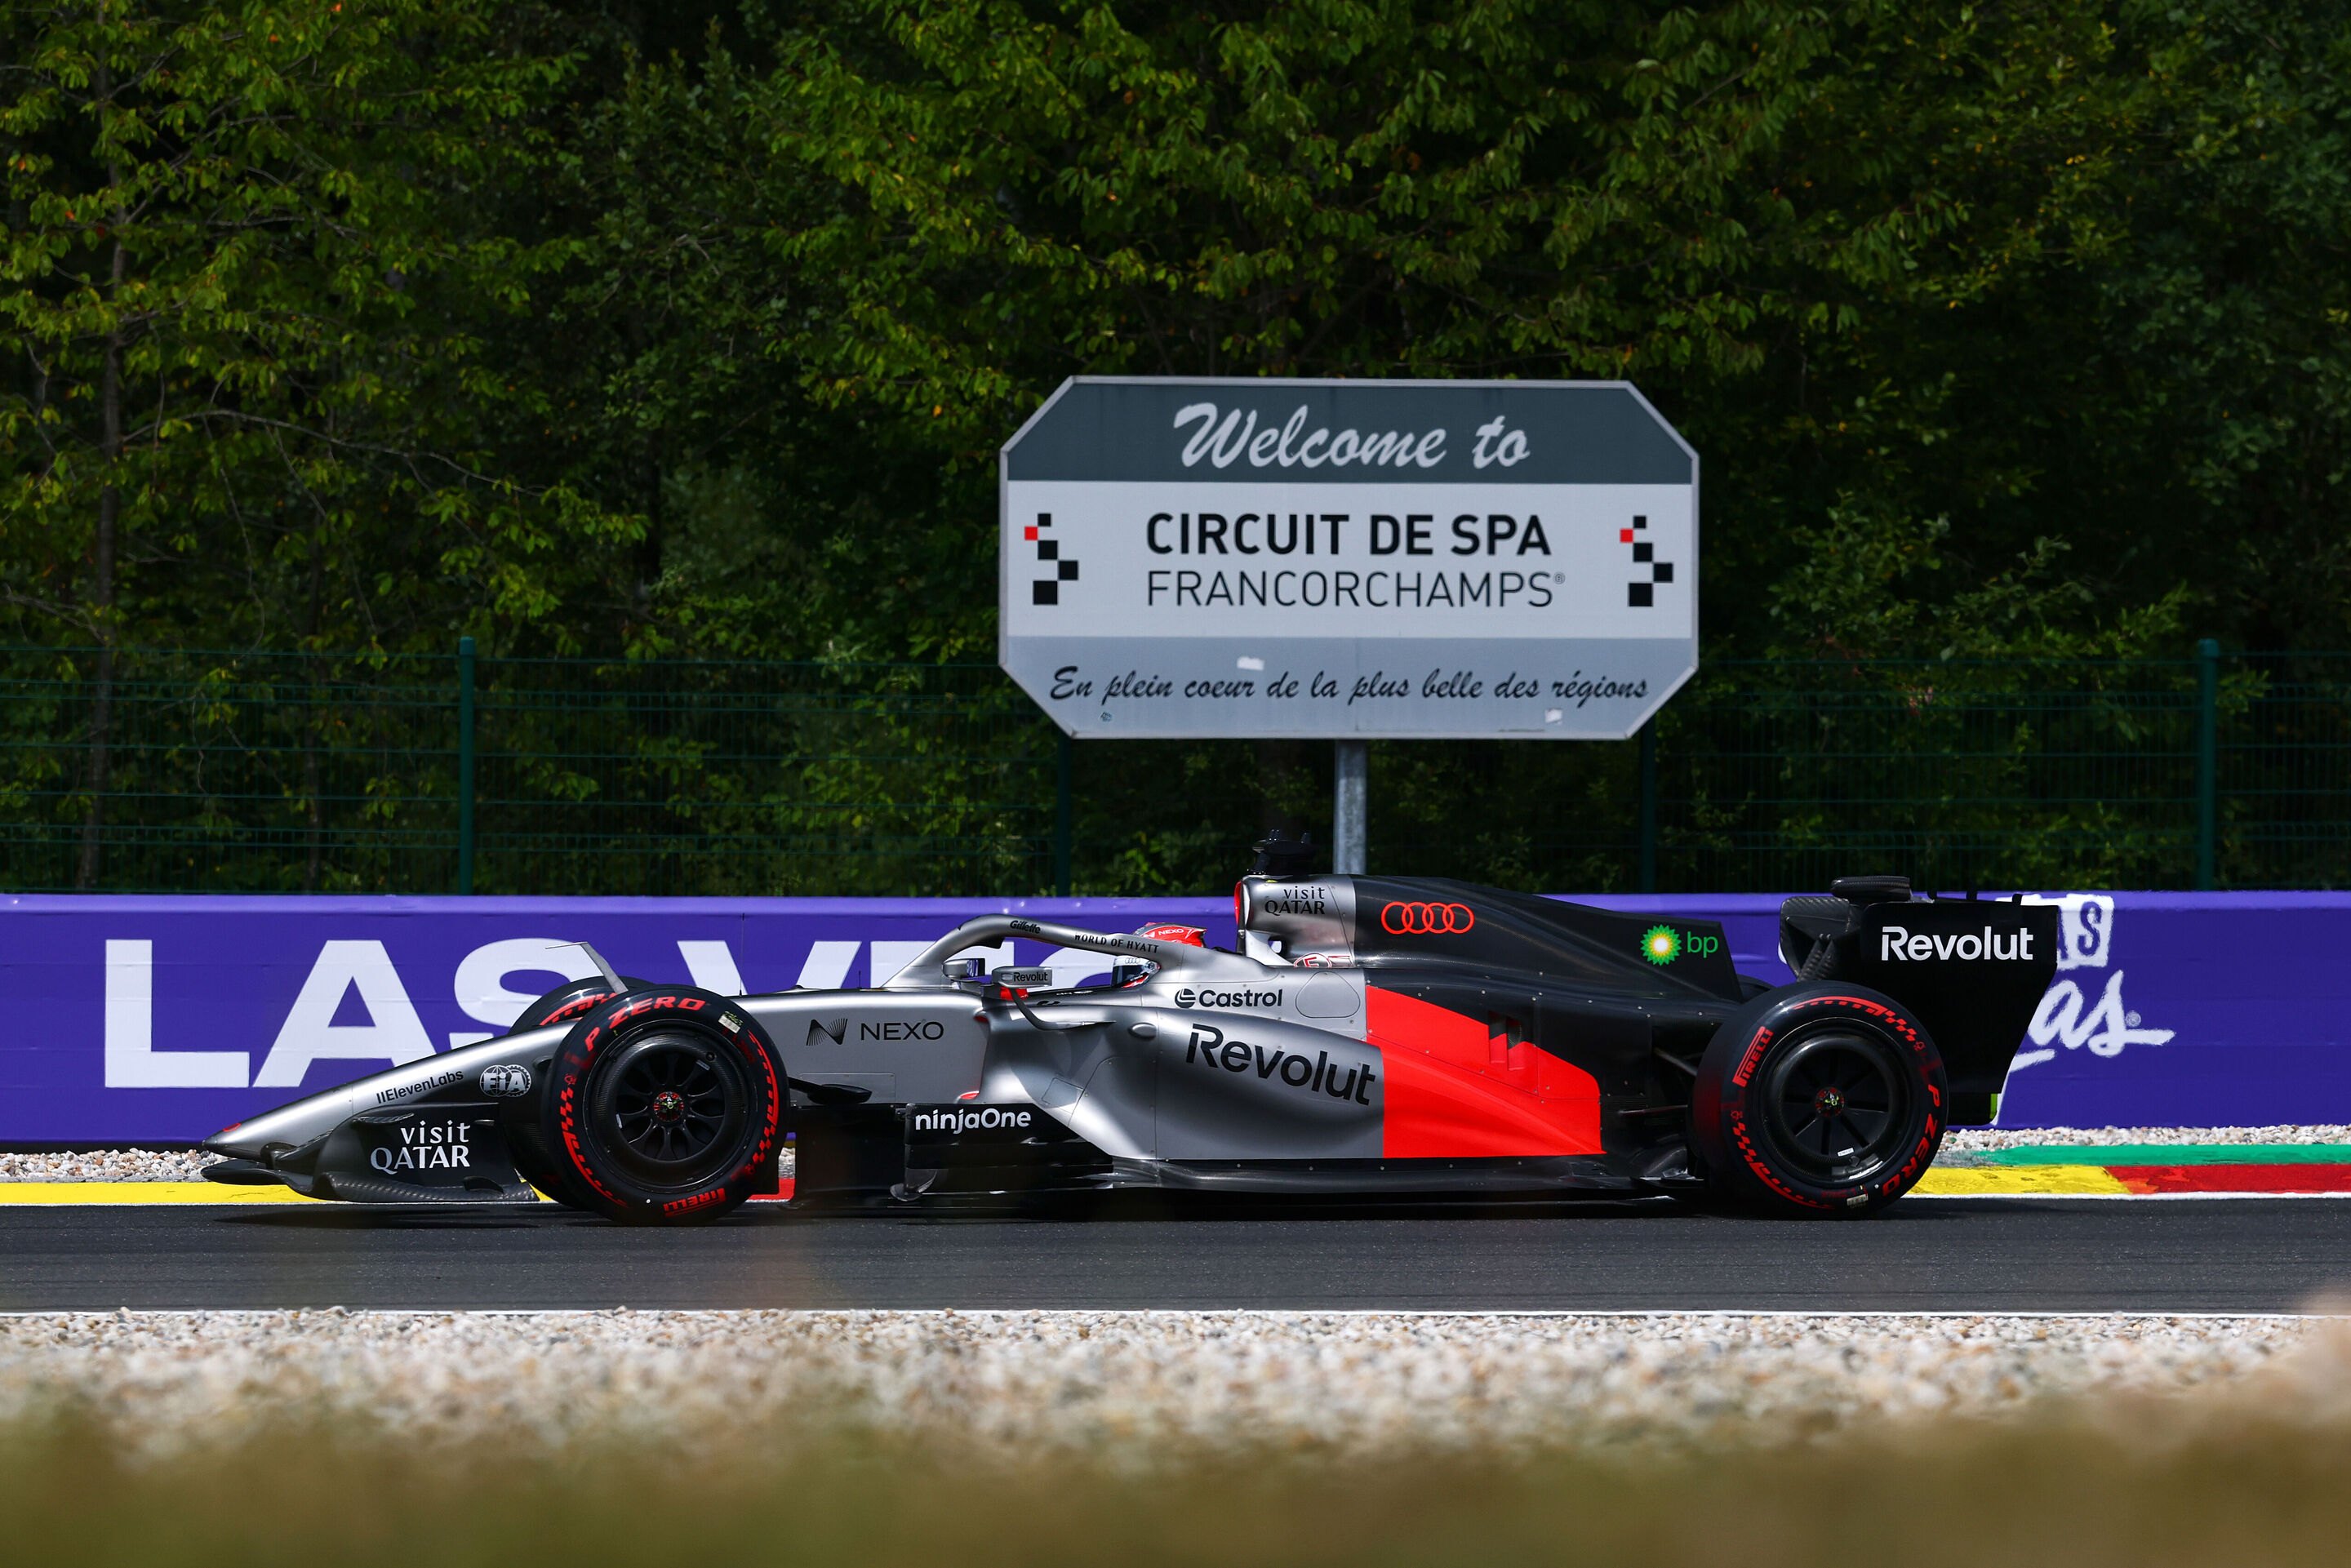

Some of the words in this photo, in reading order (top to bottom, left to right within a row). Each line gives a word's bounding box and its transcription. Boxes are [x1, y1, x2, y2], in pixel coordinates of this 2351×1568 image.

[1173, 402, 1447, 469] Welcome
[1471, 415, 1531, 470] to
[1146, 513, 1349, 556] CIRCUIT
[1370, 514, 1433, 556] DE
[1451, 514, 1552, 556] SPA
[1050, 665, 1091, 700] En
[1104, 670, 1173, 708] plein
[1184, 679, 1255, 700] coeur
[1266, 669, 1300, 701] de
[1310, 669, 1340, 700] la
[1348, 670, 1411, 708] plus
[1422, 671, 1484, 700] belle
[1494, 671, 1540, 700] des
[1552, 671, 1649, 710] régions
[1284, 886, 1325, 899] visit
[1265, 899, 1326, 916] QATAR
[1010, 920, 1041, 934] Gillette
[1074, 934, 1107, 946] WORLD
[1111, 939, 1124, 948] OF
[1127, 941, 1160, 953] HYATT
[1687, 931, 1718, 959] bp
[1882, 926, 2033, 961] Revolut
[1013, 972, 1048, 982] Revolut
[1199, 989, 1282, 1007] Castrol
[584, 1026, 600, 1052] P
[608, 996, 707, 1029] ZERO
[860, 1021, 944, 1040] NEXO
[1186, 1024, 1376, 1106] Revolut
[1732, 1026, 1774, 1087] PIRELLI
[1927, 1084, 1940, 1107] P
[401, 1120, 471, 1144] visit
[915, 1108, 1031, 1134] ninjaOne
[371, 1144, 471, 1175] QATAR
[1882, 1113, 1938, 1197] ZERO
[663, 1188, 727, 1217] PIRELLI
